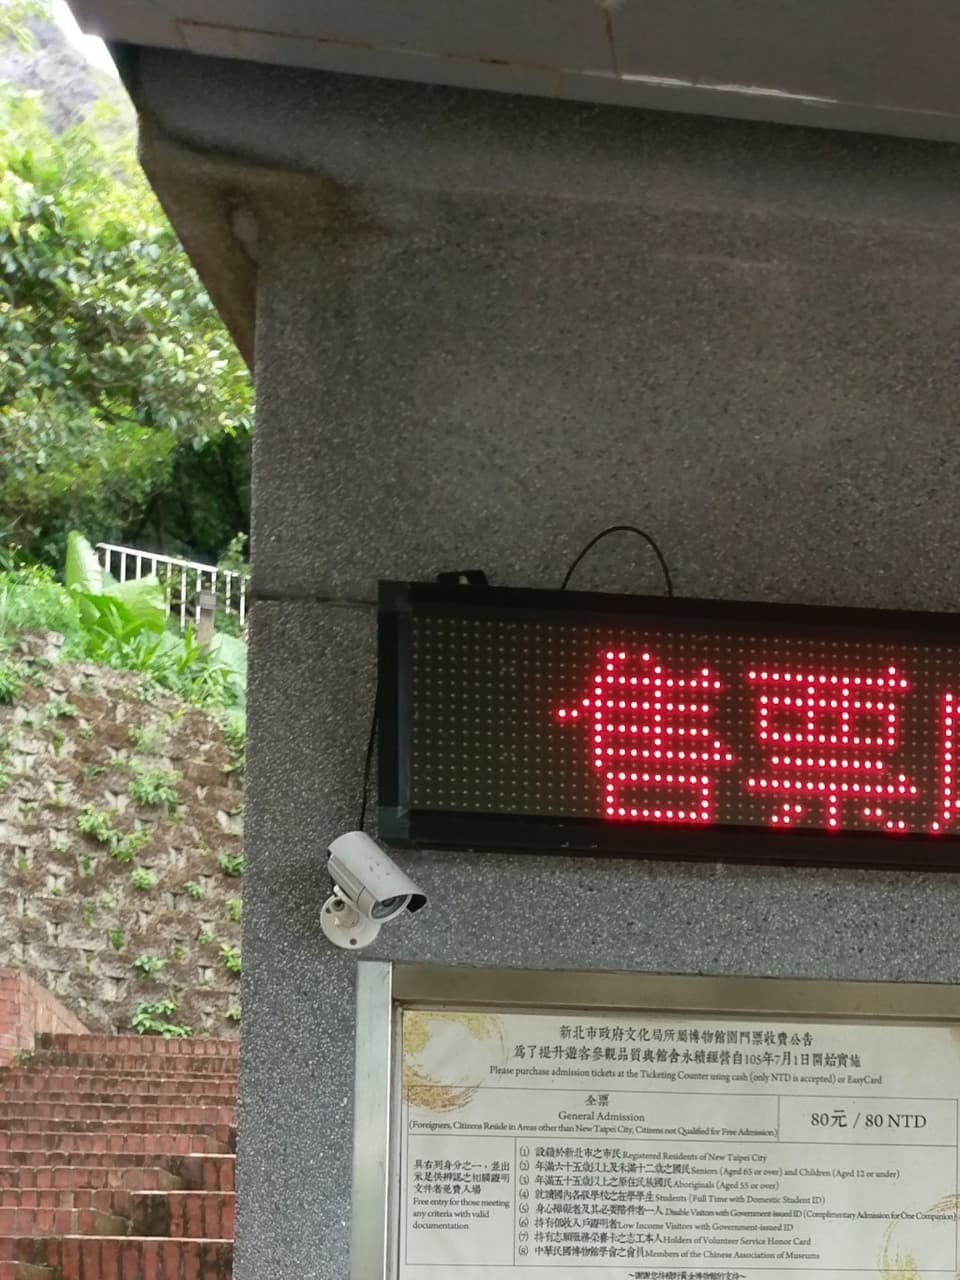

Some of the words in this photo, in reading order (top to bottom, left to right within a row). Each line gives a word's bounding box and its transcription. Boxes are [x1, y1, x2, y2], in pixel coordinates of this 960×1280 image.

[559, 1024, 814, 1047] 新北市政府文化局所屬博物館園門票收費公告
[489, 1065, 514, 1075] Please
[515, 1066, 549, 1077] purchase
[552, 1067, 590, 1077] admission
[591, 1067, 616, 1077] tickets
[617, 1069, 625, 1078] at
[626, 1068, 638, 1078] the
[640, 1070, 676, 1081] Ticketing
[677, 1071, 709, 1080] Counter
[711, 1072, 731, 1083] using
[732, 1072, 748, 1081] cash
[750, 1072, 769, 1083] (only
[770, 1073, 791, 1082] NTD
[793, 1074, 799, 1082] is
[801, 1074, 836, 1085] accepted)
[838, 1076, 847, 1084] or
[848, 1075, 882, 1086] EasyCard
[585, 1094, 609, 1107] 全票
[558, 1111, 595, 1121] General
[597, 1112, 646, 1122] Admission
[810, 1109, 848, 1128] 80元
[865, 1114, 884, 1128] 80
[888, 1114, 927, 1128] NTD
[409, 1120, 453, 1132] (Foreigners,
[453, 1121, 483, 1130] Citizens
[484, 1122, 507, 1130] Reside
[518, 1123, 537, 1132] Areas
[538, 1124, 557, 1132] other
[558, 1123, 575, 1132] than
[576, 1124, 593, 1133] New
[594, 1124, 616, 1135] Taipei
[617, 1125, 634, 1135] City,
[635, 1126, 664, 1135] Citizens
[665, 1127, 676, 1135] not
[678, 1126, 710, 1137] Qualified
[711, 1127, 720, 1136] for
[721, 1127, 737, 1137] Free
[622, 1152, 661, 1162] Registered
[663, 1152, 698, 1161] Residents
[709, 1152, 725, 1161] New
[726, 1153, 750, 1164] Taipei
[751, 1153, 767, 1163] City
[691, 1166, 718, 1175] Seniors
[720, 1167, 742, 1178] (Aged
[743, 1168, 752, 1176] 65
[763, 1167, 782, 1177] over)
[784, 1168, 798, 1176] and
[799, 1168, 831, 1177] Children
[832, 1168, 855, 1179] (Aged
[856, 1170, 865, 1178] 12
[876, 1169, 900, 1180] under)
[674, 1180, 714, 1191] Aboriginals
[716, 1180, 739, 1192] (Aged
[740, 1182, 749, 1190] 55
[760, 1181, 780, 1191] over)
[412, 1197, 429, 1206] Free
[430, 1197, 448, 1208] entry
[449, 1197, 460, 1206] for
[461, 1198, 480, 1206] those
[481, 1199, 511, 1209] meeting
[655, 1193, 687, 1202] Students
[689, 1194, 707, 1204] (Full
[708, 1194, 728, 1203] Time
[729, 1194, 745, 1203] with
[746, 1195, 780, 1204] Domestic
[782, 1196, 810, 1204] Student
[811, 1196, 826, 1206] ID)
[412, 1210, 426, 1219] any
[427, 1209, 452, 1218] criteria
[454, 1209, 470, 1218] with
[471, 1210, 490, 1218] valid
[690, 1208, 714, 1217] Visitors
[715, 1208, 729, 1217] with
[803, 1209, 856, 1221] (Complimentary
[857, 1211, 890, 1220] Admission
[891, 1211, 900, 1220] for
[901, 1211, 914, 1220] One
[412, 1221, 469, 1230] documentation
[619, 1221, 634, 1230] Low
[636, 1221, 663, 1230] Income
[665, 1222, 693, 1231] Visitors
[695, 1222, 711, 1231] with
[783, 1223, 793, 1232] ID
[663, 1235, 692, 1244] Holders
[703, 1236, 738, 1245] Volunteer
[740, 1236, 766, 1245] Service
[767, 1236, 791, 1246] Honor
[793, 1237, 811, 1246] Card
[644, 1249, 679, 1258] Members
[690, 1249, 701, 1258] the
[703, 1250, 732, 1259] Chinese
[734, 1250, 776, 1260] Association
[786, 1251, 820, 1261] Museums
